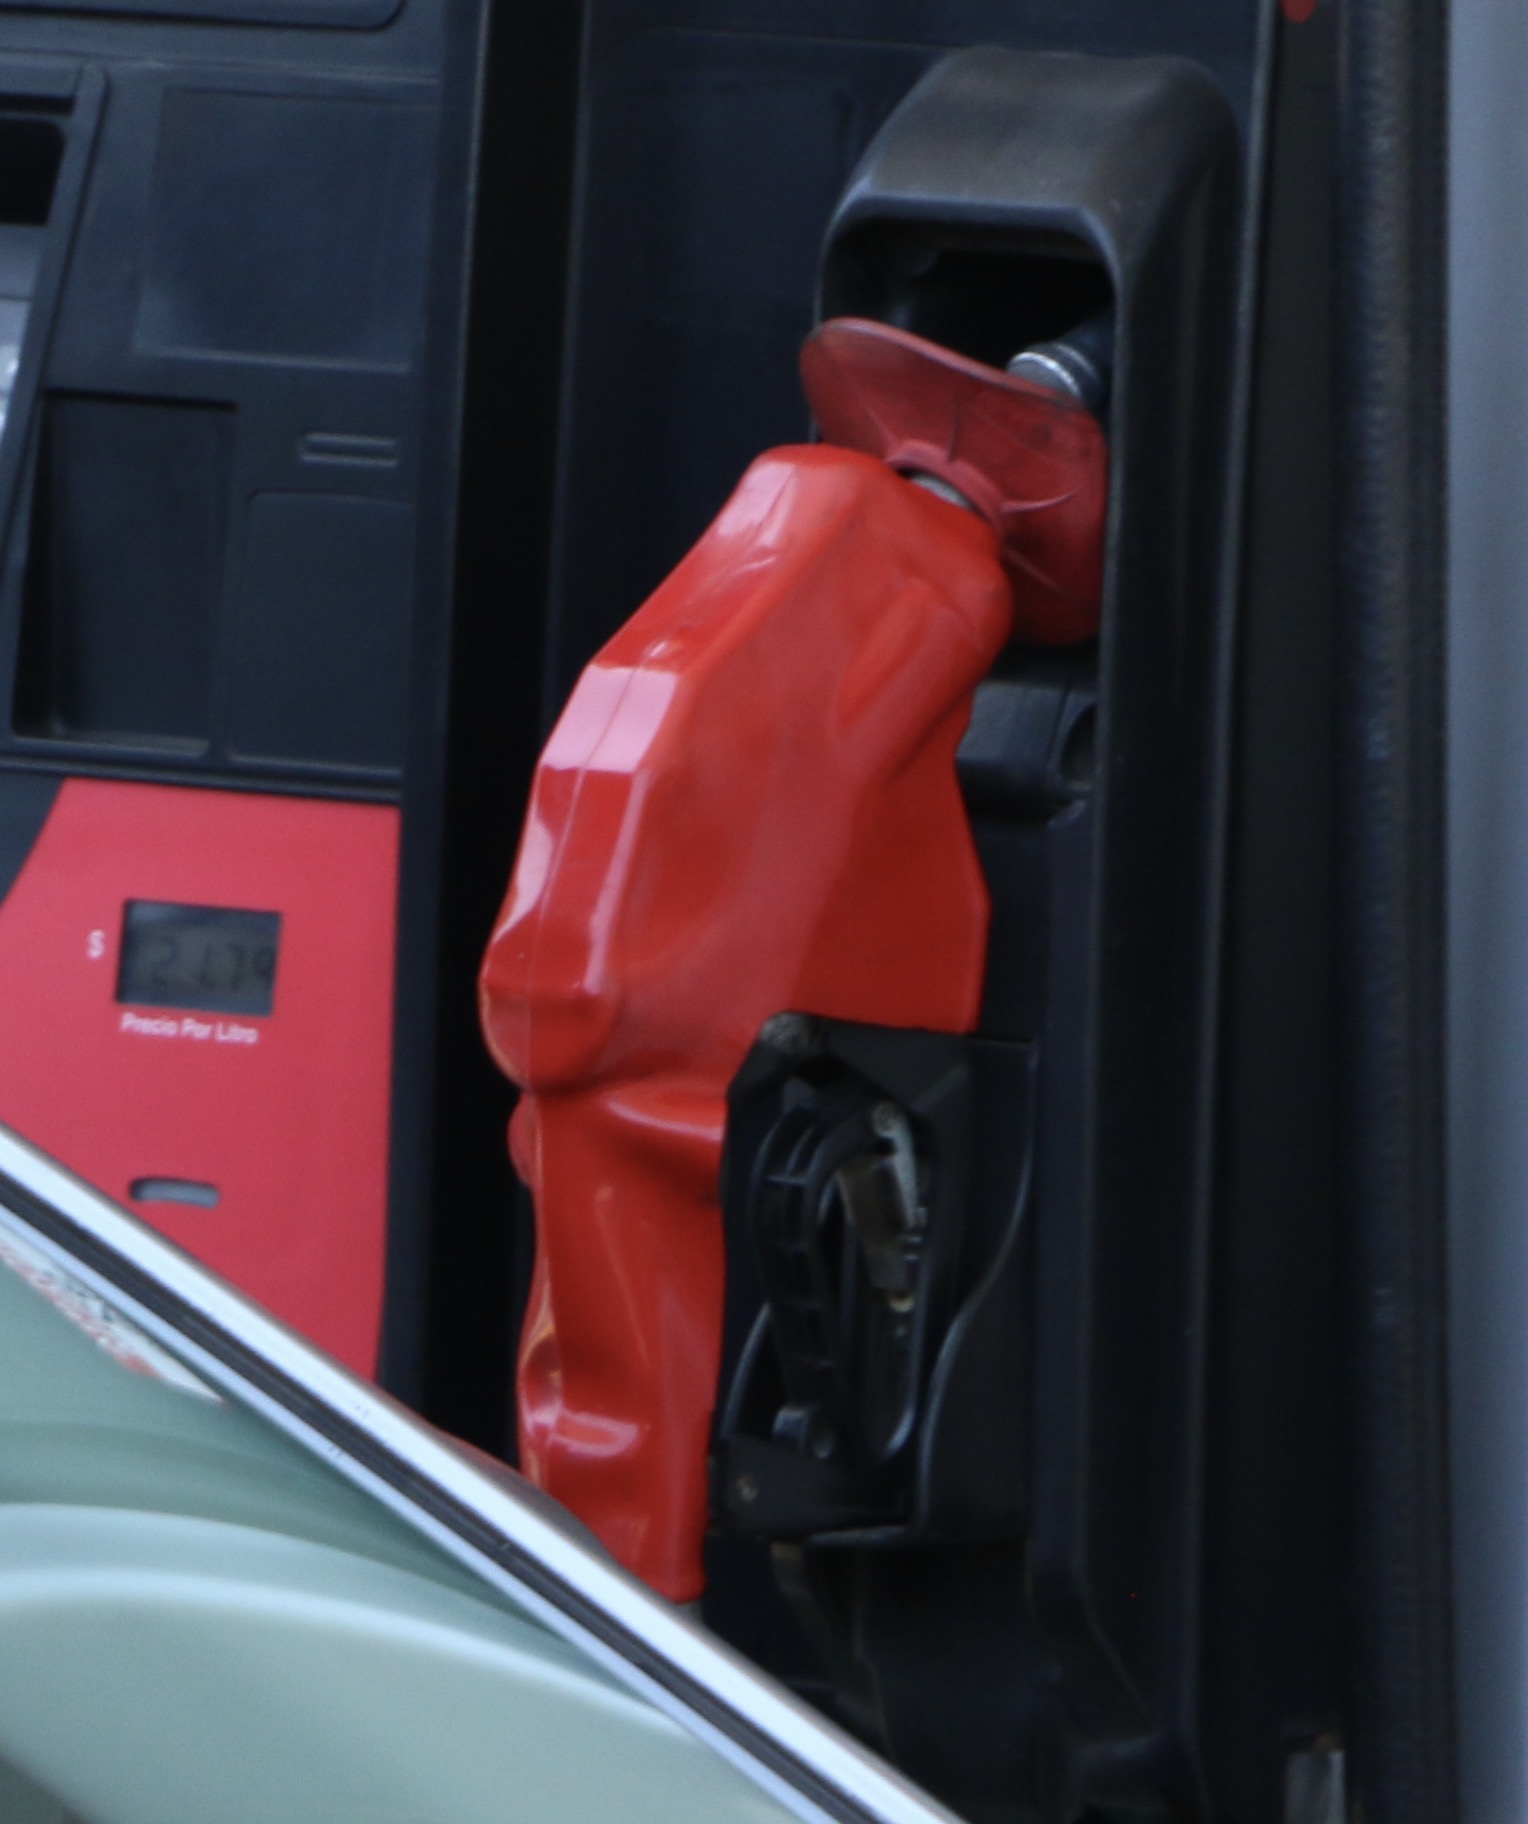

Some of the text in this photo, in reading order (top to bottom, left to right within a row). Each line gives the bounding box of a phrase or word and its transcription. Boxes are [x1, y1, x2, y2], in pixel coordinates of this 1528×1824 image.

[120, 1012, 259, 1045] Precio Por Litro
